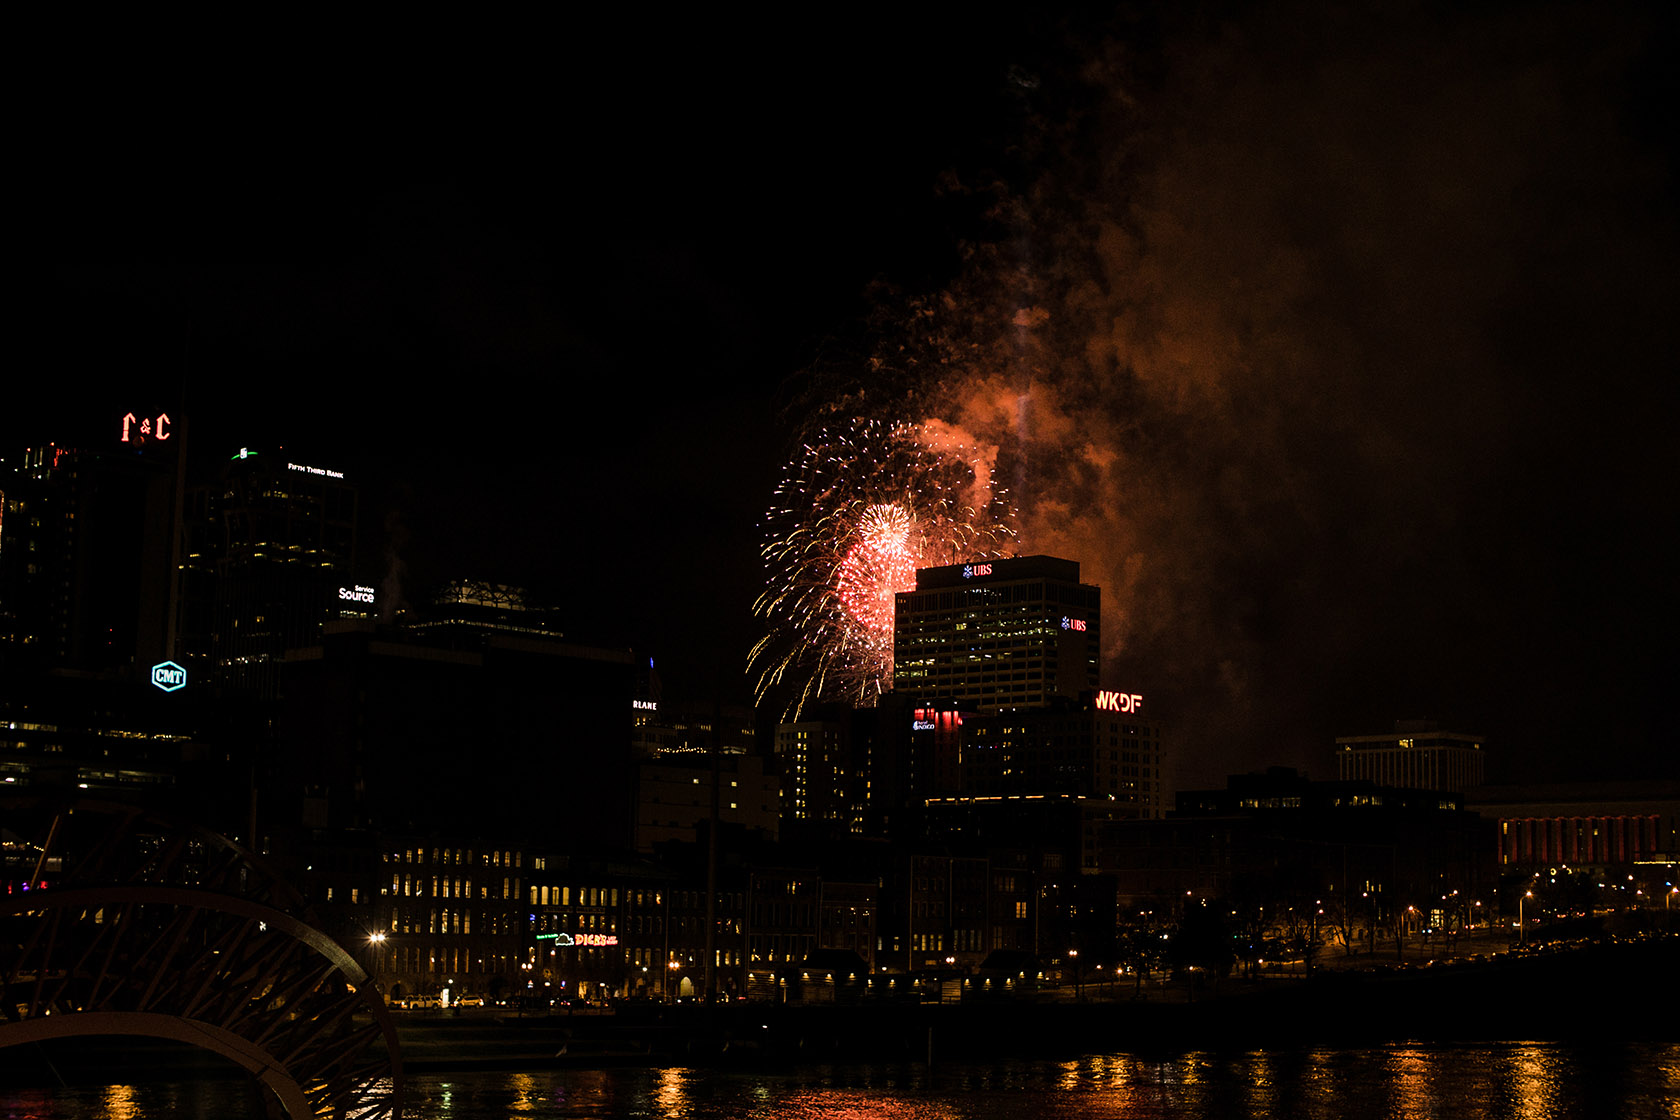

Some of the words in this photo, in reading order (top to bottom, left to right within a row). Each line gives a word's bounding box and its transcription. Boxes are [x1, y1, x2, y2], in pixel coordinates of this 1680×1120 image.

[287, 462, 306, 473] FIFTH
[306, 466, 326, 476] THIRD
[326, 469, 344, 479] BANK
[973, 563, 993, 577] UBS
[338, 587, 375, 604] Source
[354, 584, 375, 594] Service
[1070, 618, 1087, 632] UBS
[155, 668, 183, 684] CMT
[1095, 689, 1143, 715] WKDF
